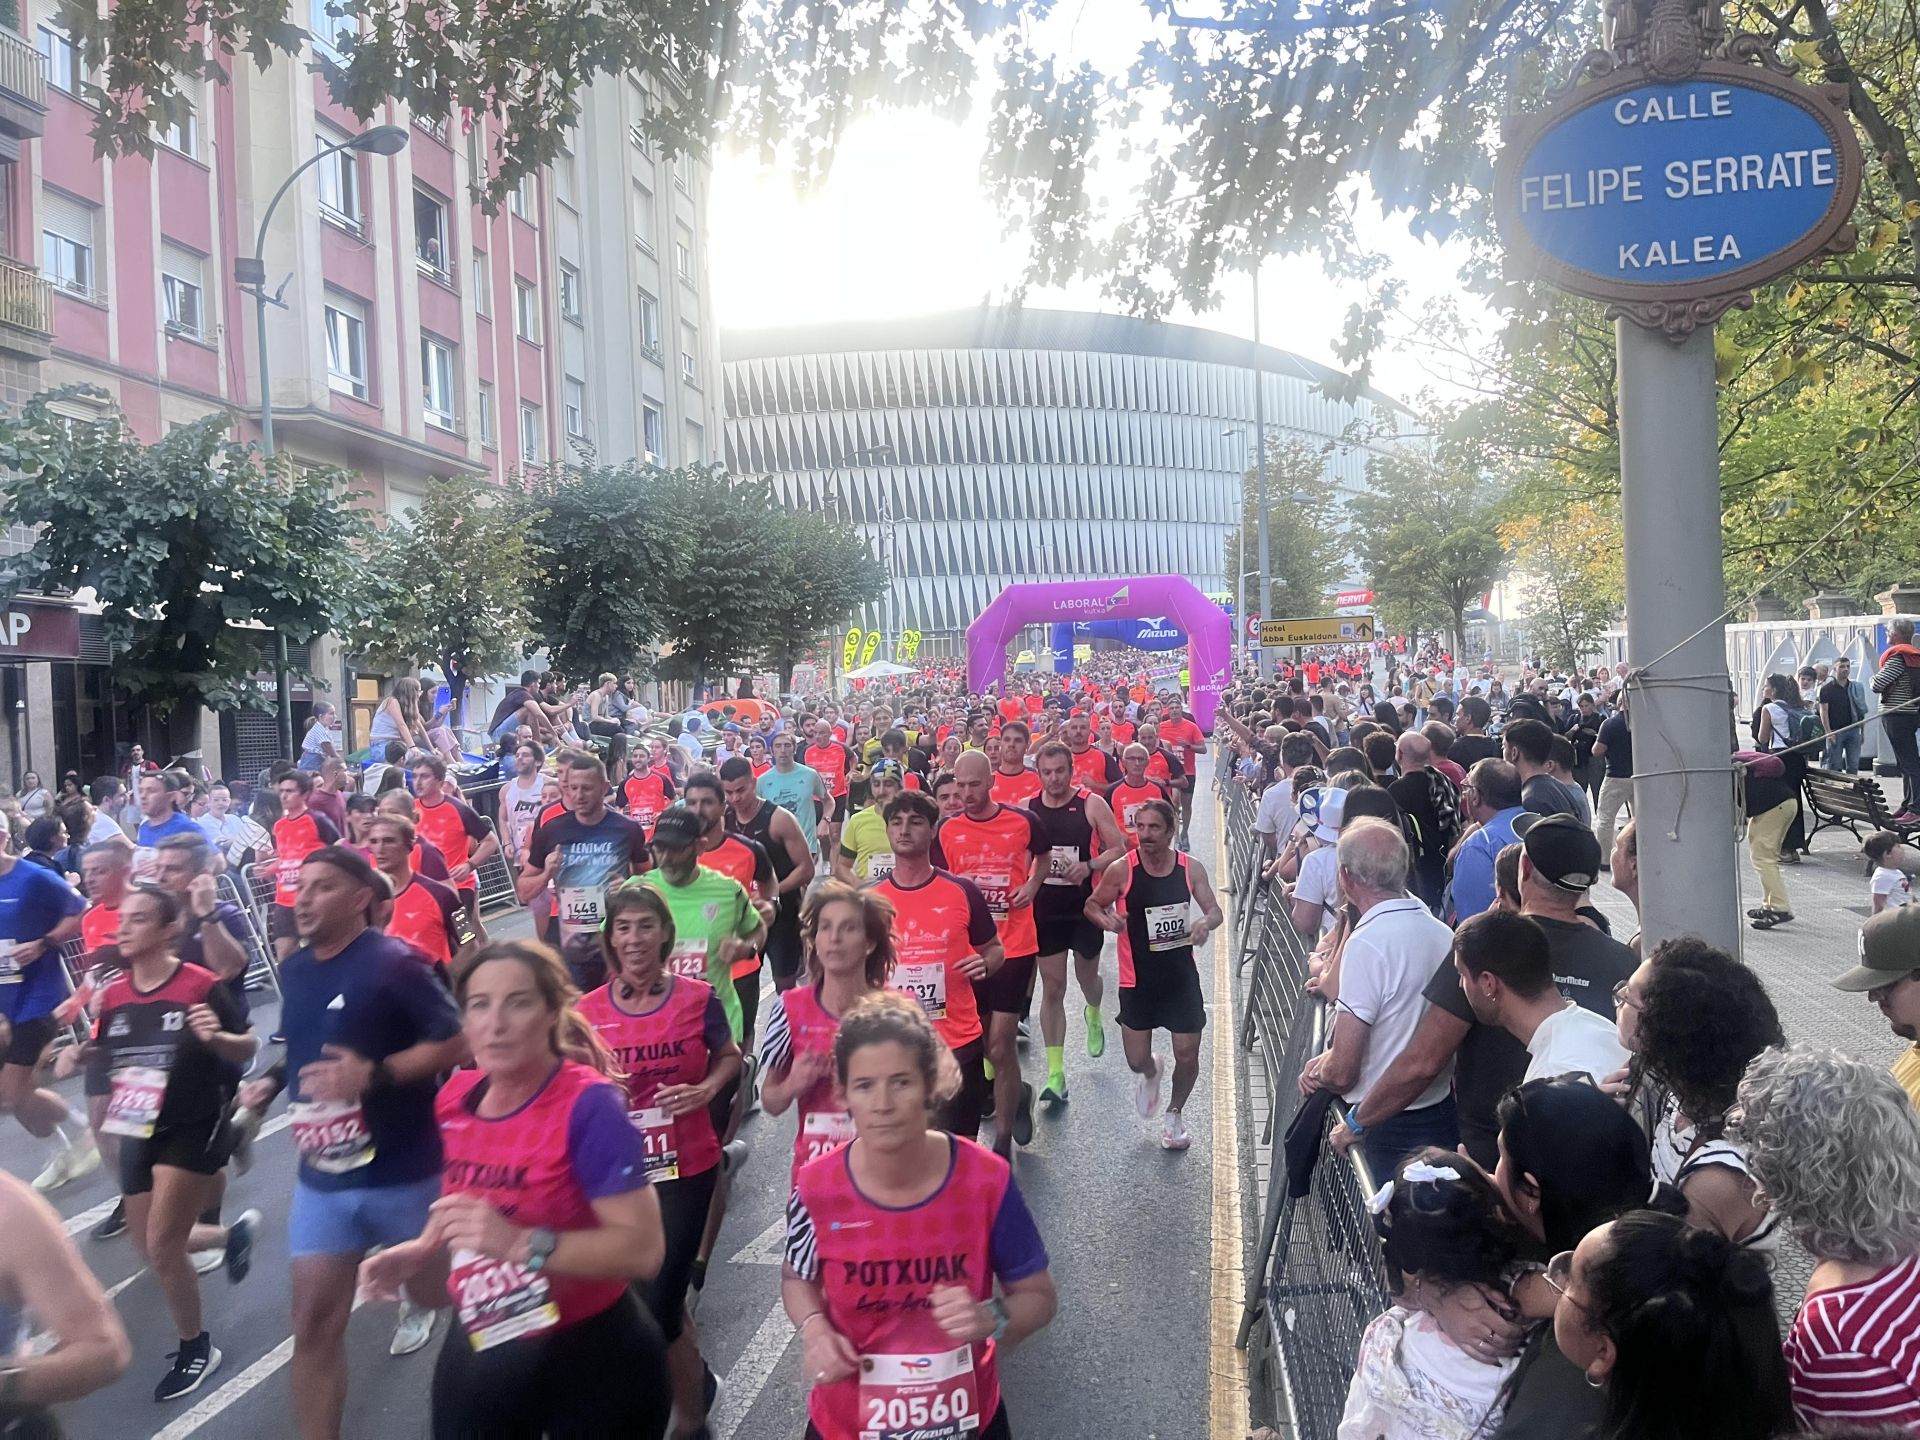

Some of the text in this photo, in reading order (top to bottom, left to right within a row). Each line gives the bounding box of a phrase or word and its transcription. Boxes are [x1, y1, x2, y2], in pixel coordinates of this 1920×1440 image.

[1614, 89, 1733, 126] CALLE
[1519, 147, 1835, 213] FELIPE SERRATE
[1617, 234, 1743, 269] KALEA
[1053, 598, 1105, 610] LABORAL
[1137, 629, 1178, 638] MIZUNO
[1262, 632, 1337, 643] Abba Euskalduna
[567, 902, 597, 915] 1448
[1155, 918, 1185, 934] 2002
[842, 1253, 970, 1287] POTXUAK
[867, 1387, 969, 1430] 20560
